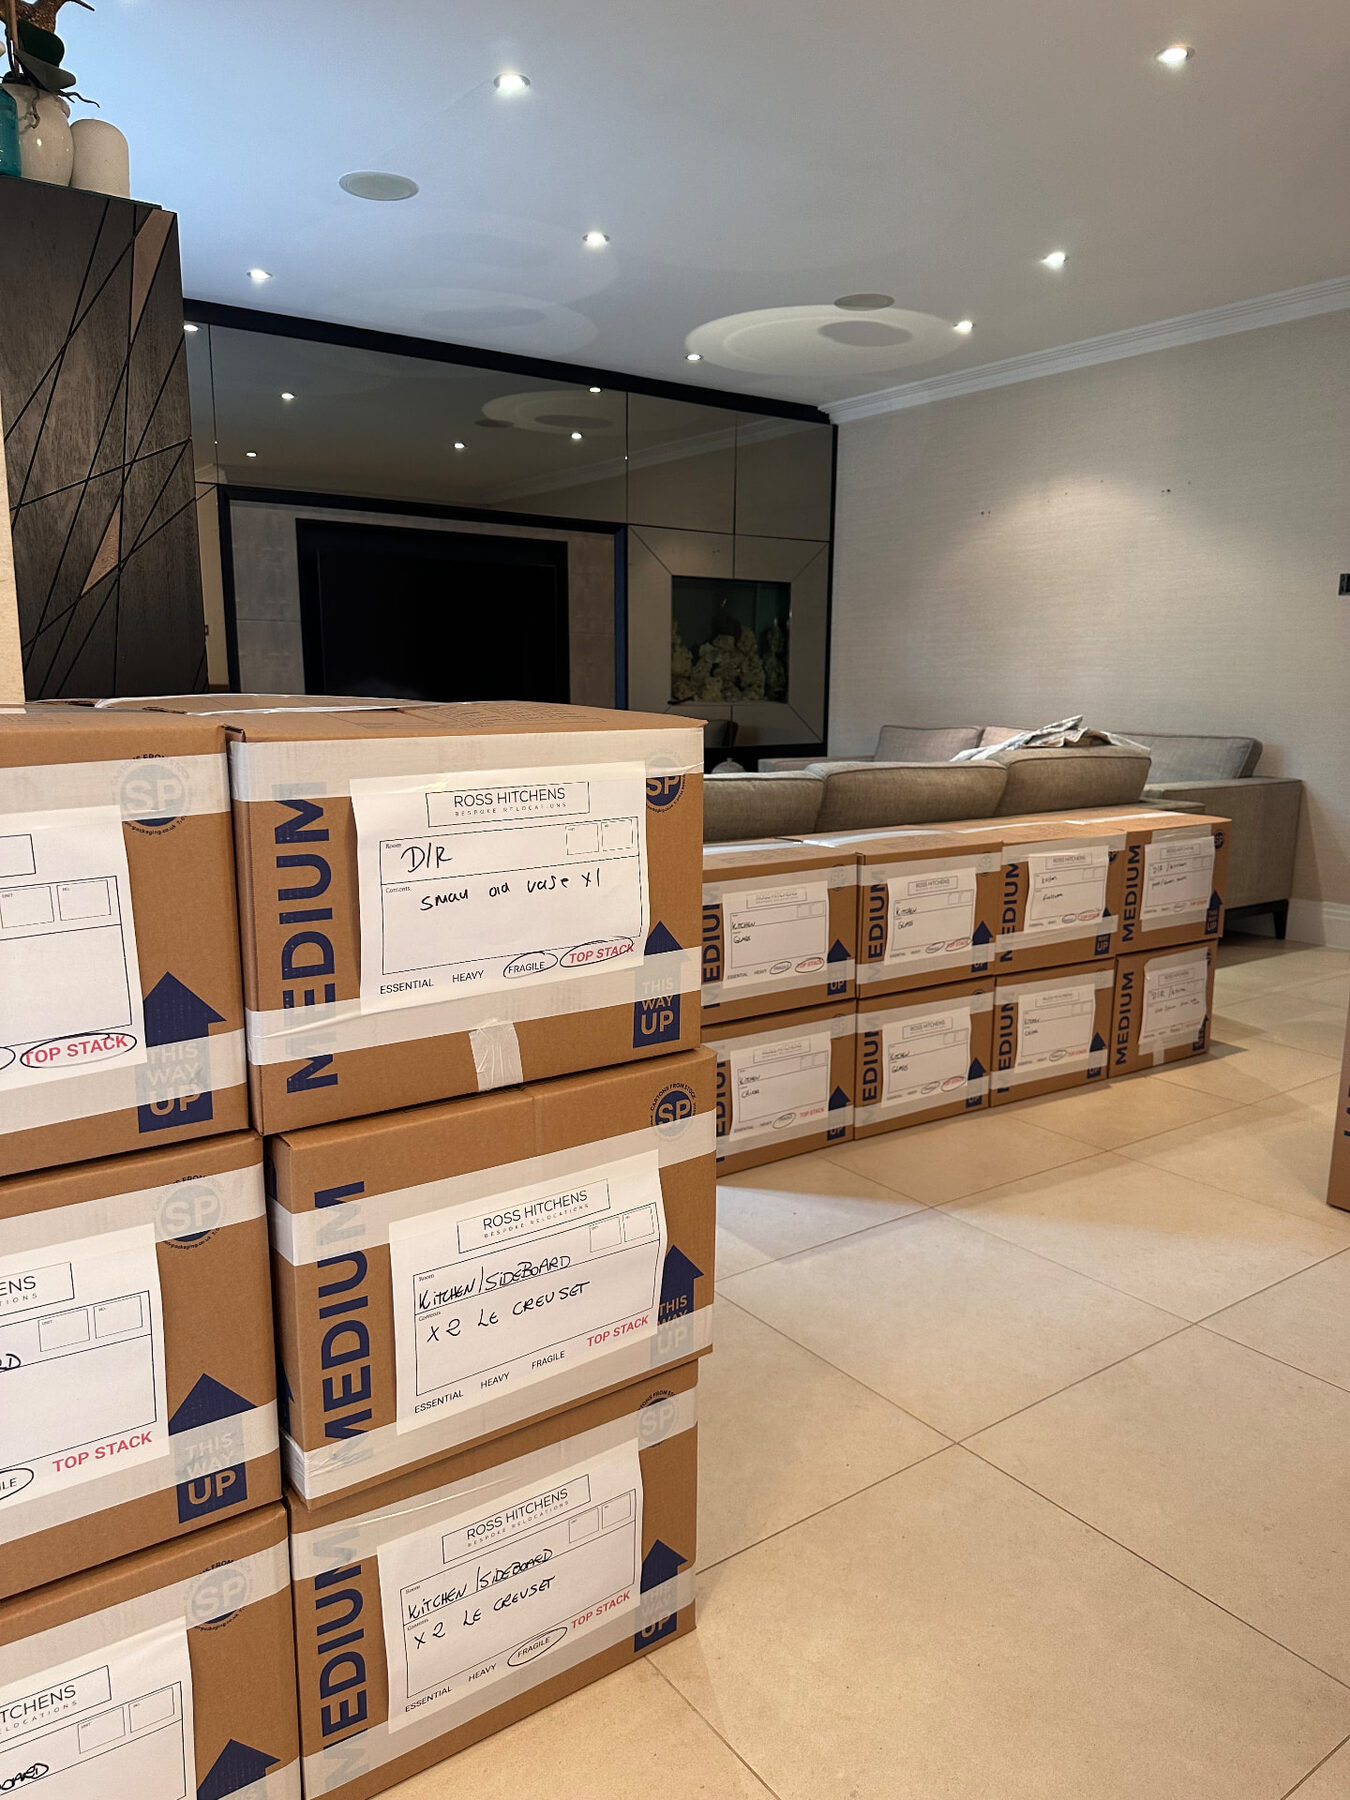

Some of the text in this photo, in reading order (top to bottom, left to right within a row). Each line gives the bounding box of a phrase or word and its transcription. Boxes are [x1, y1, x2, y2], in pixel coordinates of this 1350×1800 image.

[453, 787, 566, 808] ROSS HITCHENS
[646, 775, 680, 796] SP
[454, 807, 497, 817] BESPOKE
[1122, 844, 1141, 942] MEDIUM
[379, 943, 634, 995] ESSENTIAL HEAVY FRAGILE TOP STACK
[642, 977, 674, 995] THIS
[641, 995, 673, 1012] WAY
[1115, 972, 1135, 1066] MEDIUM
[640, 1011, 674, 1035] UP
[25, 1035, 128, 1065] TOP STACK
[147, 1042, 199, 1064] THIS
[146, 1062, 200, 1086] WAY
[149, 1083, 201, 1116] UP
[658, 1099, 691, 1127] SP
[166, 1194, 218, 1233] SP
[483, 1190, 588, 1231] ROSS HITCHENS
[483, 1223, 525, 1239] BESPOKE
[659, 1294, 688, 1316] THIS
[314, 1181, 374, 1465] MEDIUM
[657, 1325, 688, 1354] UP
[414, 1315, 649, 1414] ESSENTIAL HEAVY FRAGILE TOP STACK
[641, 1405, 674, 1436] SP
[52, 1431, 152, 1472] TOP STACK
[185, 1433, 233, 1463] THIS
[187, 1469, 236, 1505] UP
[466, 1488, 568, 1540] ROSS HITCHENS
[467, 1500, 569, 1547] BESPOKE RELOCATIONS
[197, 1577, 245, 1617] SP
[405, 1591, 631, 1713] ESSENTIAL HEAVY FRAGILE TOP STACK
